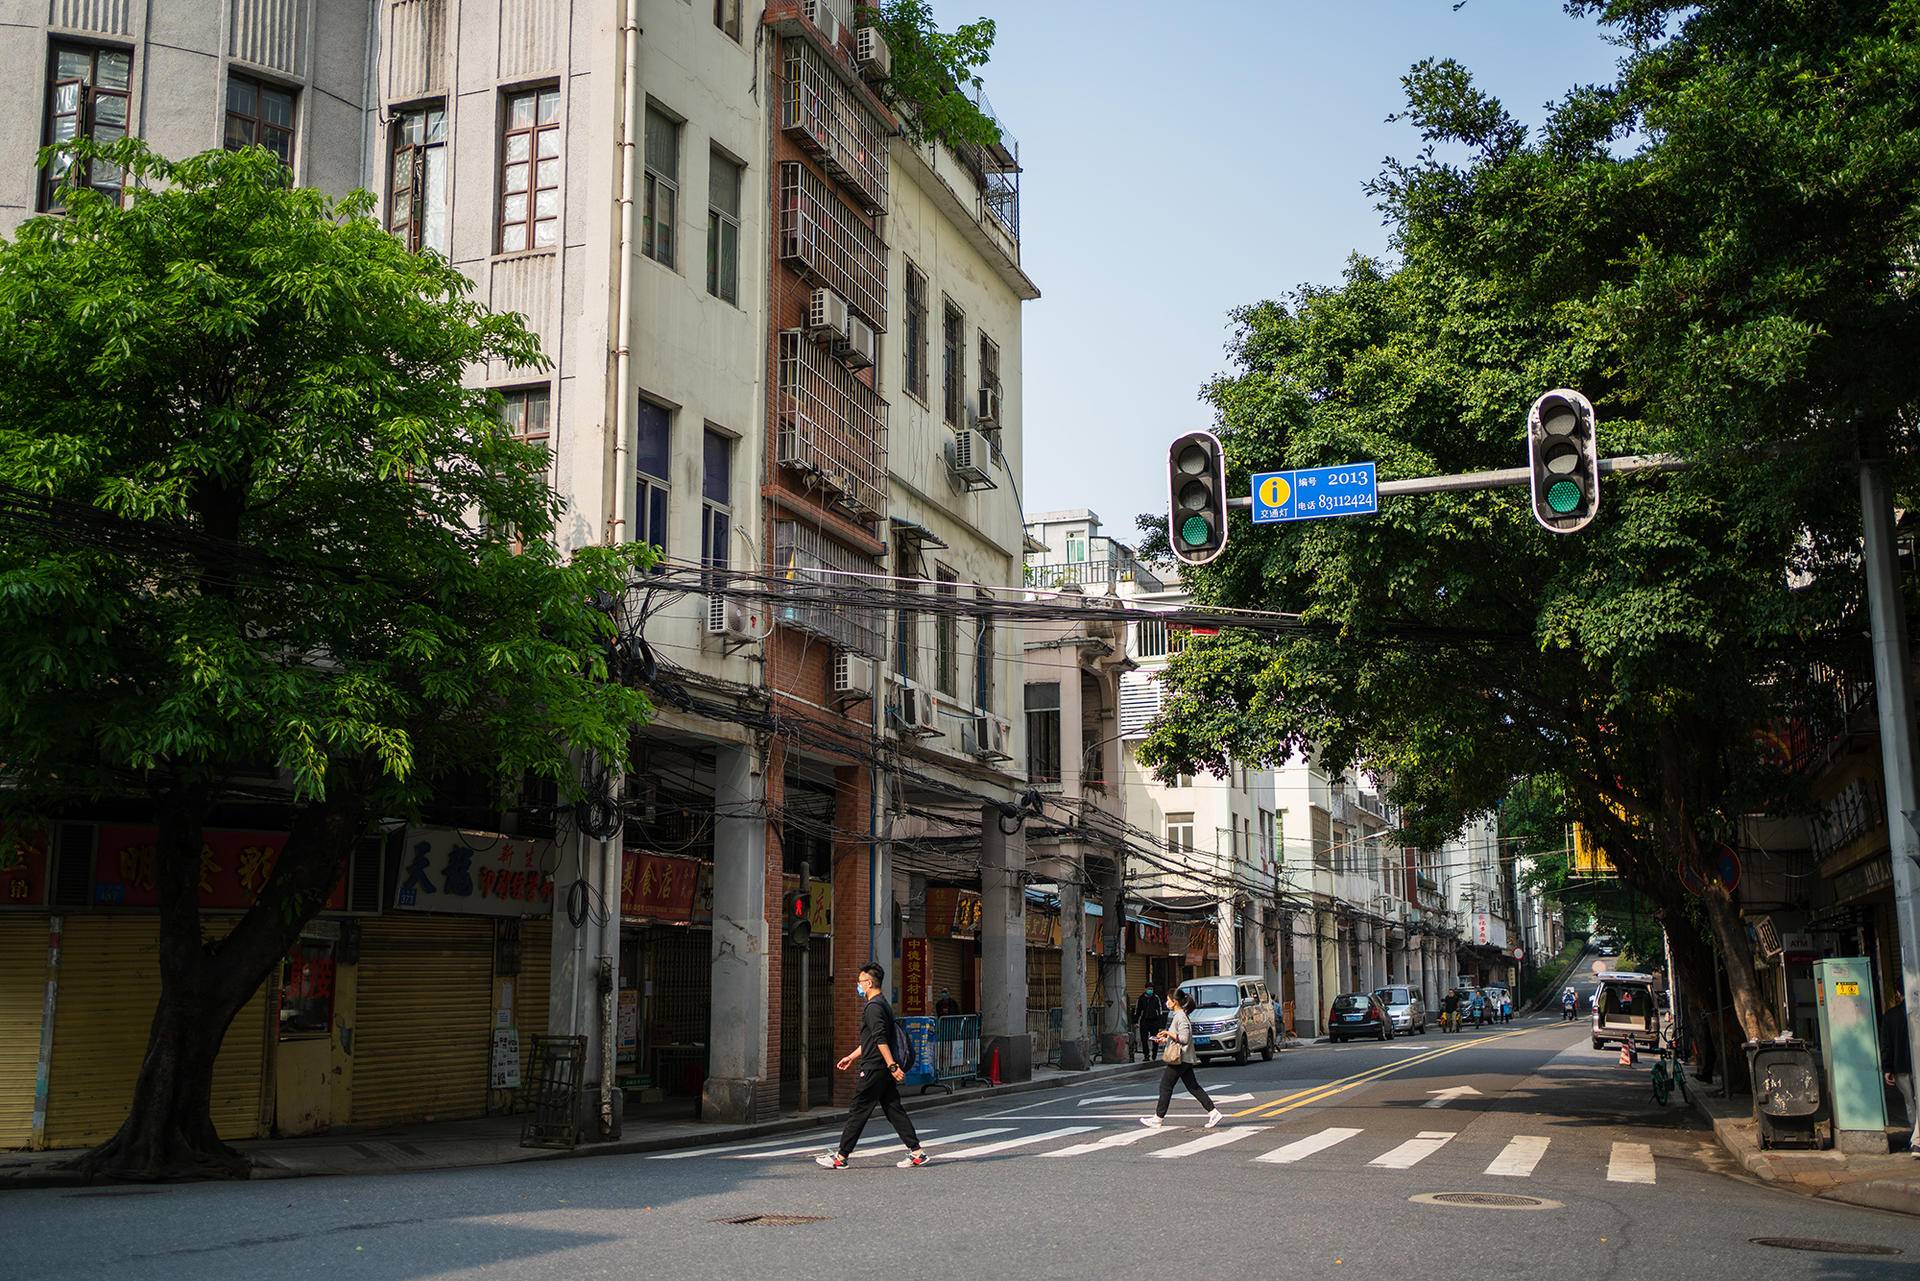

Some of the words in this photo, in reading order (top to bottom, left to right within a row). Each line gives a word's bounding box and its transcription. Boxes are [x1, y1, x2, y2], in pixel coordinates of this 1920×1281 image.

[1298, 477, 1317, 487] 编号
[1327, 471, 1368, 486] 2013
[1298, 501, 1316, 511] 电话
[1318, 494, 1373, 511] 83112424
[1260, 508, 1288, 519] 交通灯
[1791, 939, 1808, 949] ATM
